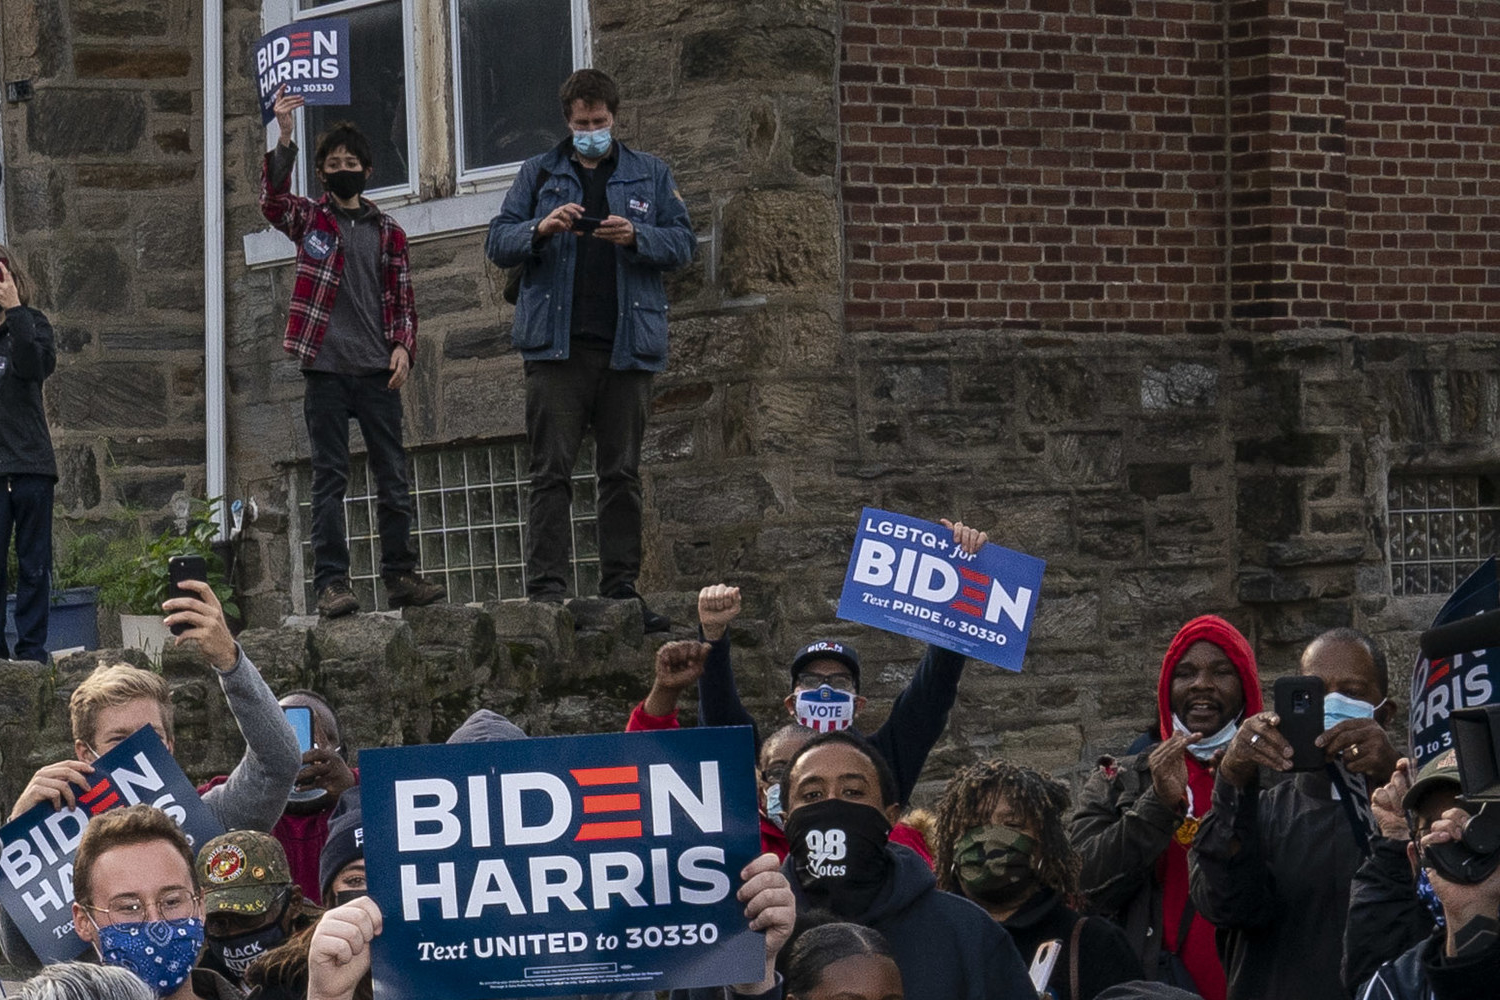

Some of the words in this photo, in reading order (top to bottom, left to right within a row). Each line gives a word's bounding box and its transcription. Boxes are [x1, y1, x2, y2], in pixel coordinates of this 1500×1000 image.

[256, 30, 338, 76] BIDEN
[259, 57, 340, 98] HARRIS
[302, 83, 335, 93] 30330
[865, 517, 949, 551] LGBTQ+
[852, 537, 1033, 633] BIDEN
[862, 591, 890, 609] Text
[892, 599, 943, 623] PRIDE
[943, 617, 956, 629] to
[958, 620, 1007, 646] 30330
[808, 704, 843, 718] VOTE
[1412, 664, 1493, 735] RRIS
[1427, 738, 1440, 755] to
[0, 751, 165, 890] BIDEN
[394, 760, 724, 852] BIDEN
[805, 828, 847, 861] 98
[399, 845, 731, 922] HARRIS
[223, 940, 263, 959] BLACK
[417, 940, 468, 962] Text
[473, 931, 589, 957] UNITED
[596, 935, 619, 951] to
[626, 922, 719, 949] 30330
